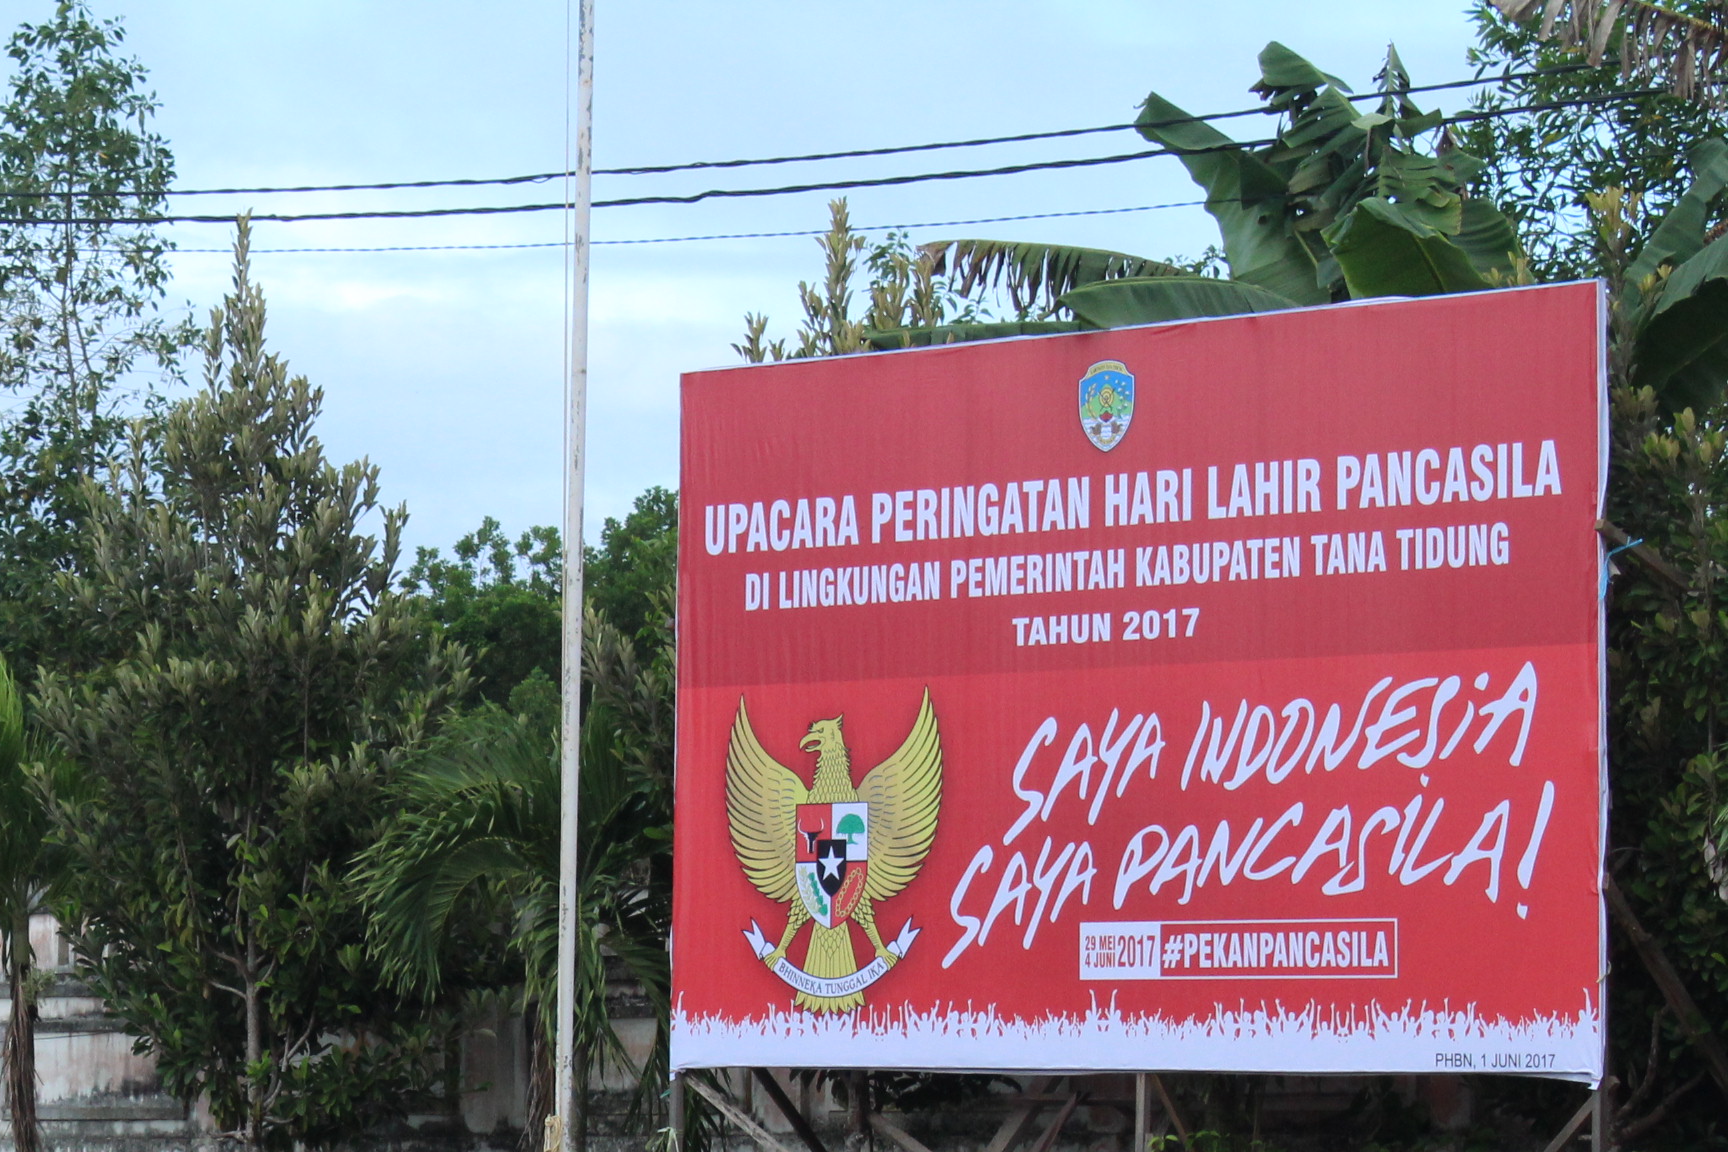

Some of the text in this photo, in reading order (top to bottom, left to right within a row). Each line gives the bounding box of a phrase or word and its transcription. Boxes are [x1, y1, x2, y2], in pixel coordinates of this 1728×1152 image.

[704, 440, 1562, 556] UPACARA PERINGATAN HARI LAHIR PANCASILA
[745, 522, 1510, 611] DI LINGKUNGAN PEMERINTAH KABUPATEN TANA TIDUNG
[1011, 607, 1201, 647] TAHUN 2017
[1003, 707, 1166, 846] SAYA
[941, 835, 1098, 969] SAYA
[1084, 934, 1116, 951] 29 MEI
[1084, 951, 1116, 968] 4 JUNI
[1117, 930, 1390, 969] 2017 #PEKANPANCASILA
[778, 961, 885, 995] BHINNEKA TUNGGAL IKA
[1435, 1052, 1556, 1069] PHBN, 1 JUNI 2017
